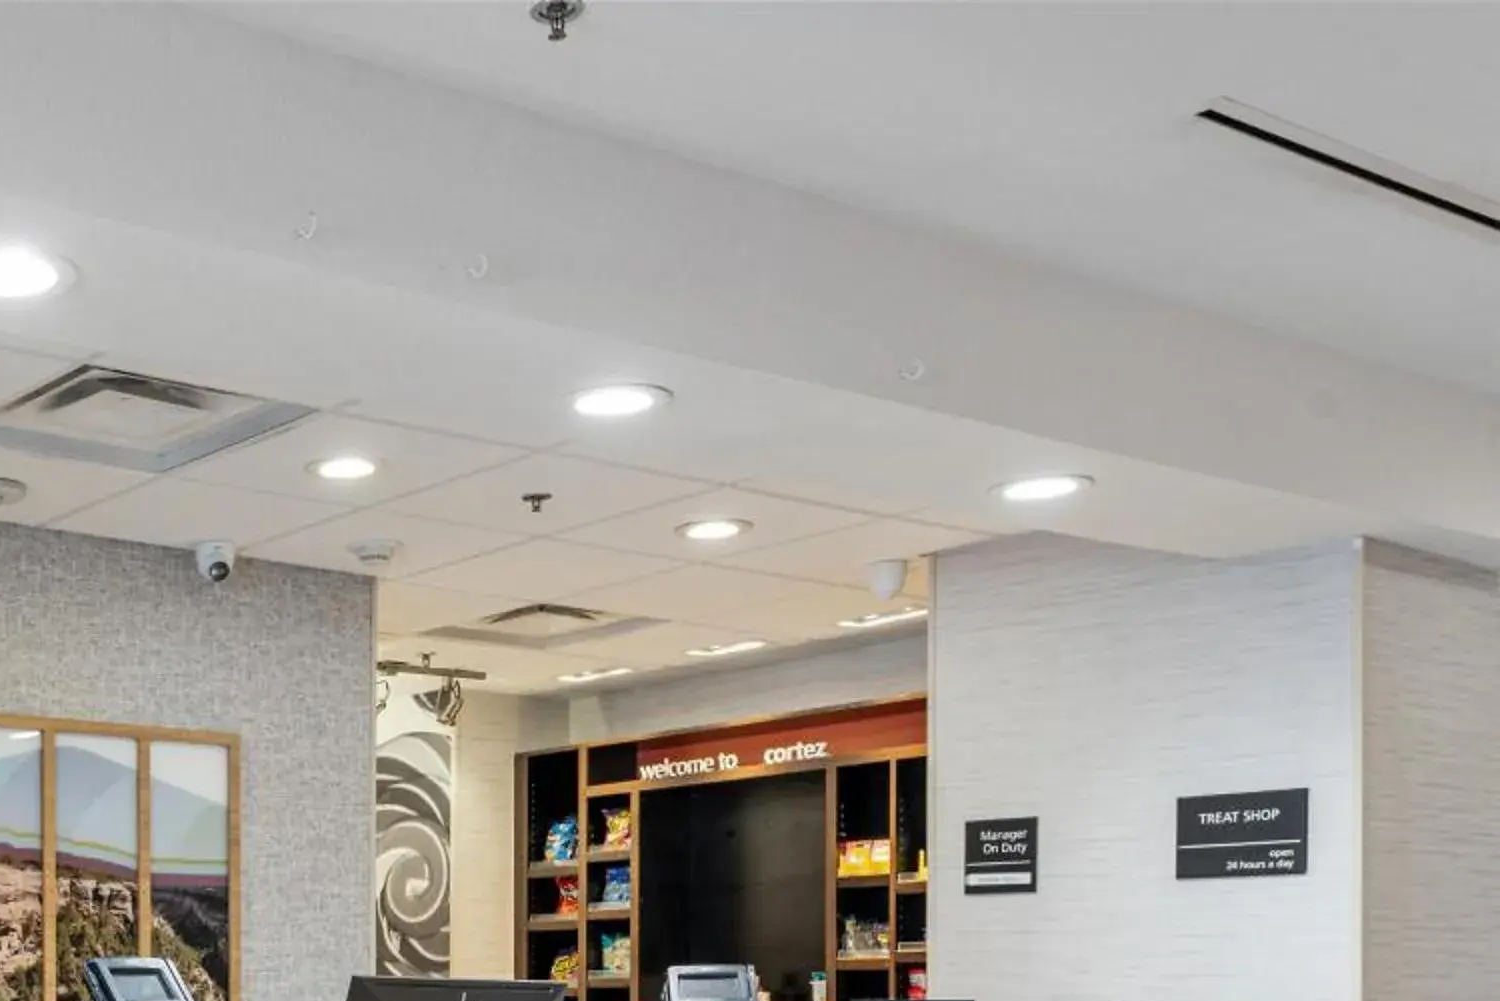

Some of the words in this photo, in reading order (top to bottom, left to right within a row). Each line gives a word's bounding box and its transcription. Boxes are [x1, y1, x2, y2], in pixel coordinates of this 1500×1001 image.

[639, 756, 715, 781] welcome
[717, 752, 739, 771] to
[763, 741, 829, 765] cortez
[1197, 811, 1240, 825] TREAT
[1243, 807, 1281, 822] SHOP
[979, 829, 1028, 843] Manager
[983, 843, 999, 855] On
[1001, 842, 1028, 855] Duty
